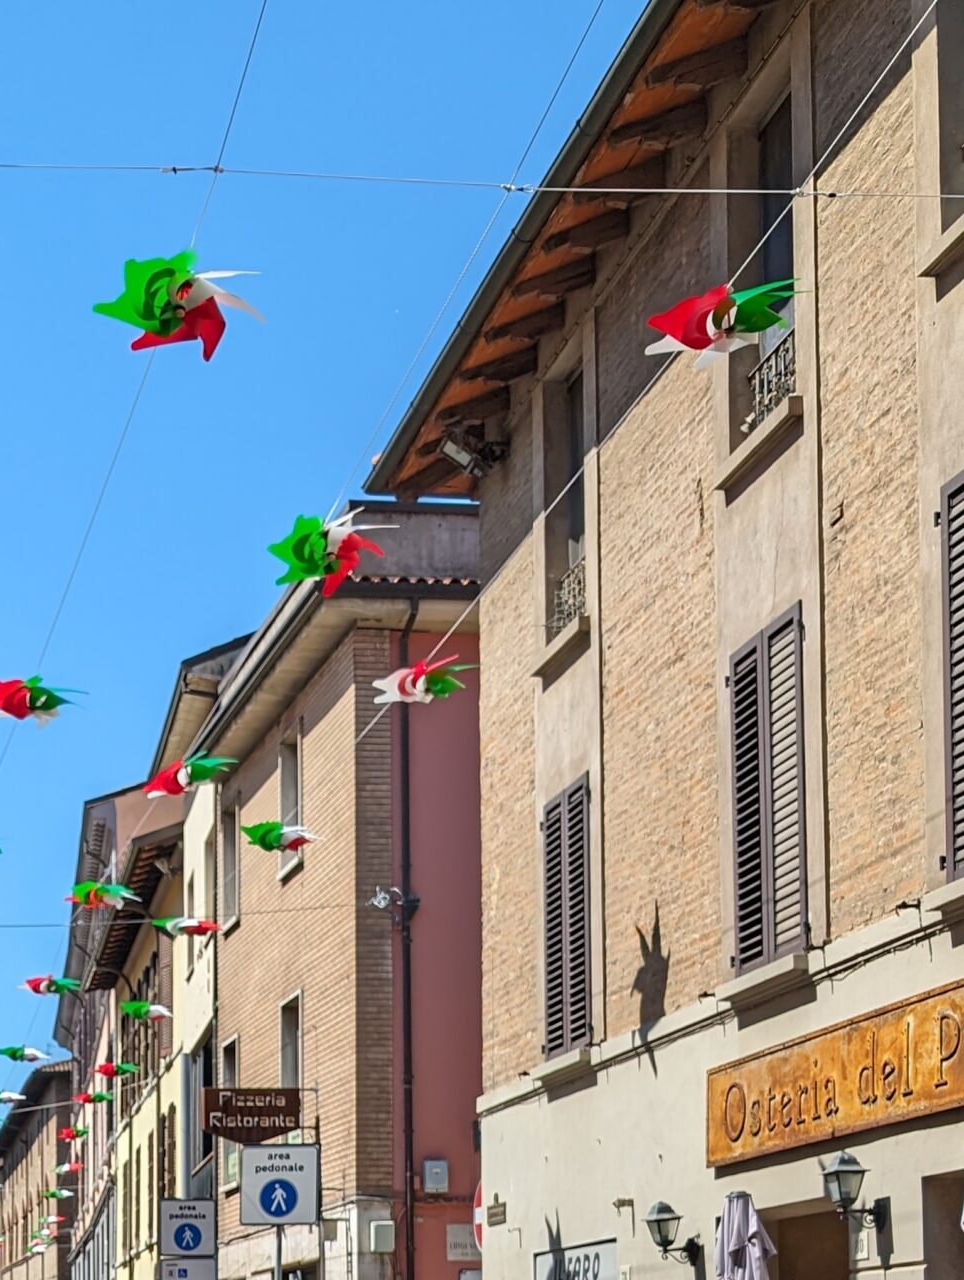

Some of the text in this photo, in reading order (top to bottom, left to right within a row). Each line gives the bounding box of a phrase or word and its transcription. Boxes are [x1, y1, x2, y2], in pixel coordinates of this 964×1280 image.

[723, 1059, 839, 1143] Osteria
[857, 1020, 914, 1105] del
[219, 1091, 286, 1107] Pizzeria
[209, 1112, 296, 1128] Ristorante
[267, 1152, 291, 1161] area
[254, 1162, 305, 1175] pedonale
[168, 1212, 207, 1220] pedonale
